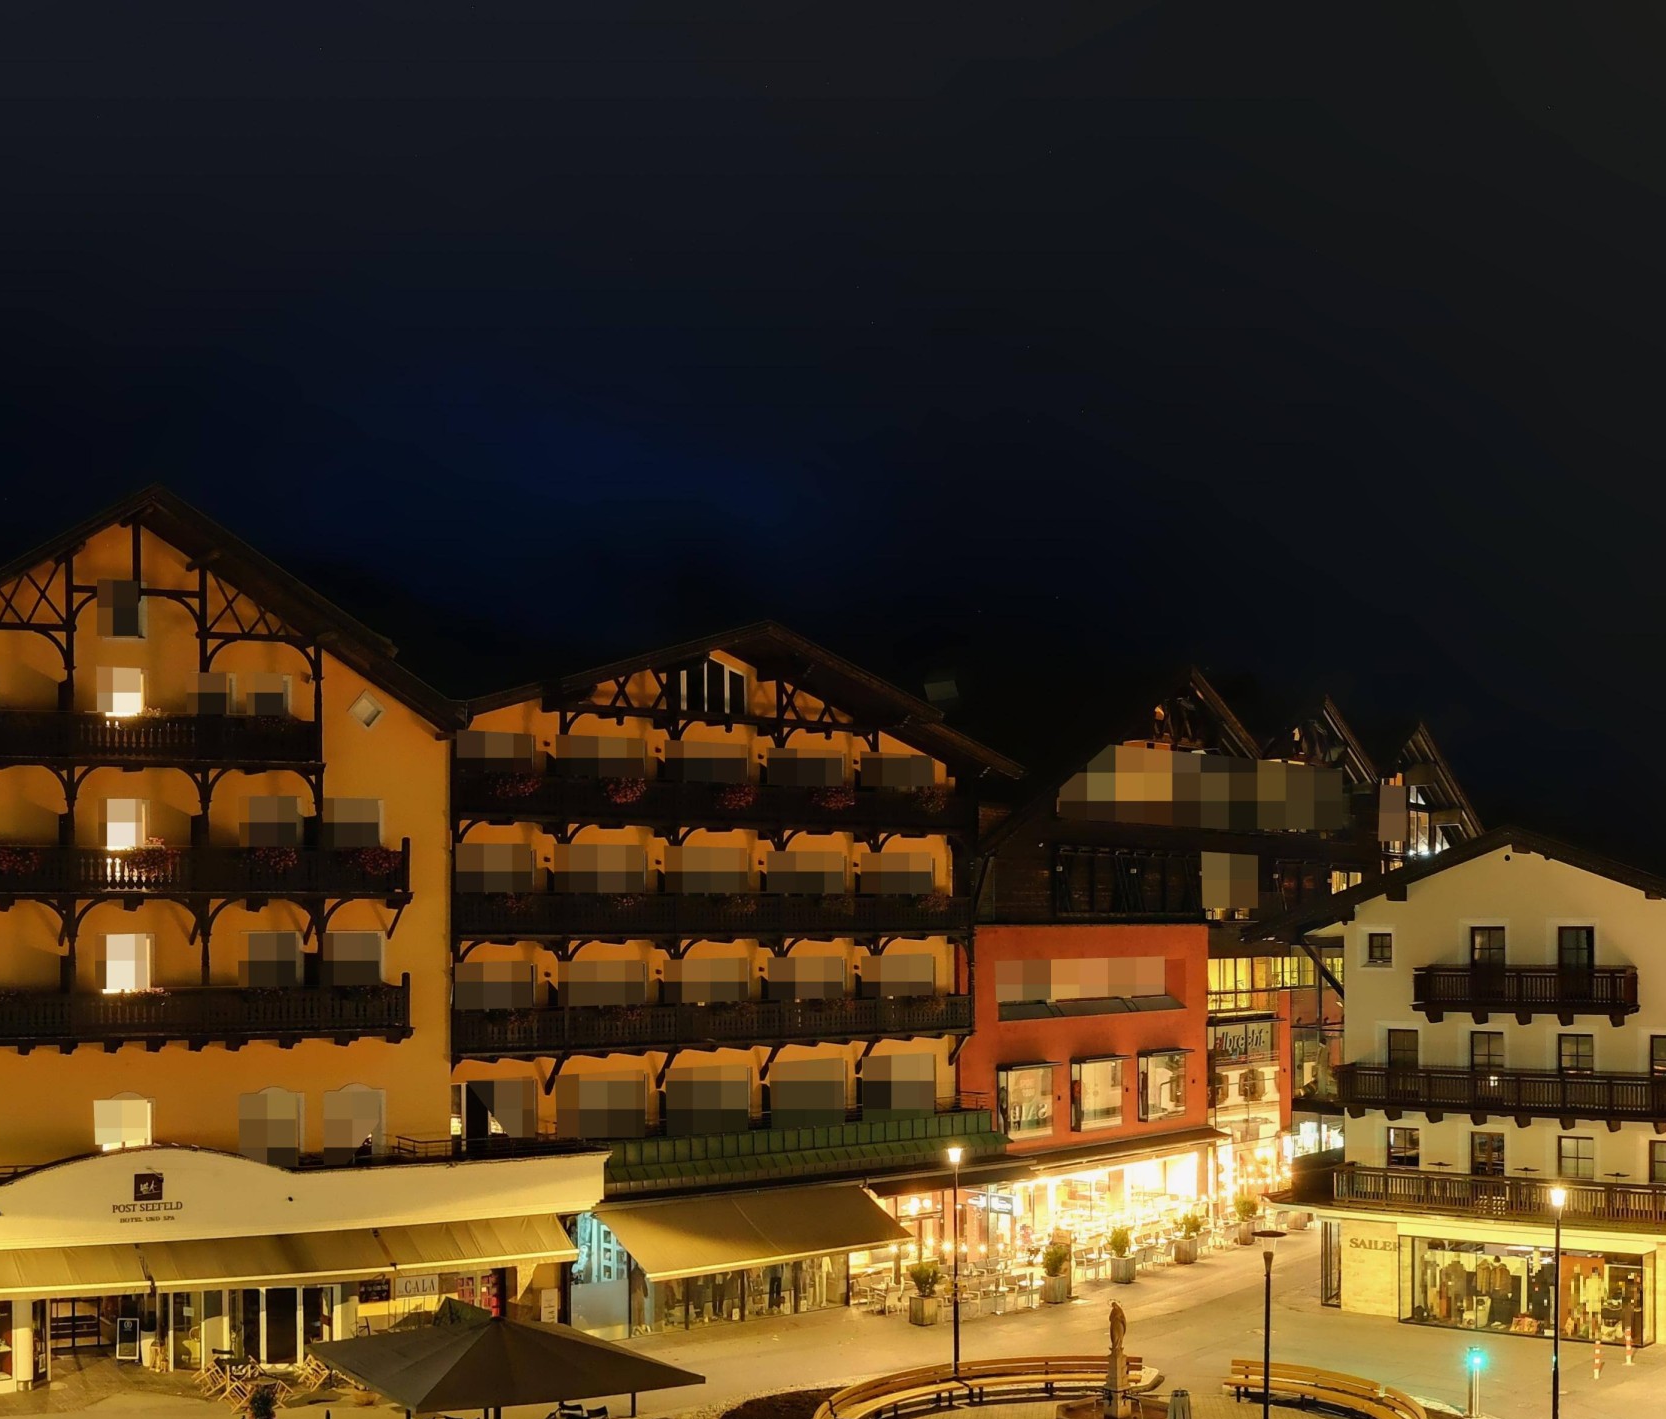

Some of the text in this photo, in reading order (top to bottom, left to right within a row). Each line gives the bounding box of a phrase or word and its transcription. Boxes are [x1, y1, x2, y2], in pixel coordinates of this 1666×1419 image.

[112, 1201, 183, 1214] POST SEEFELD
[119, 1216, 144, 1224] HOTEL
[145, 1215, 161, 1223] UND
